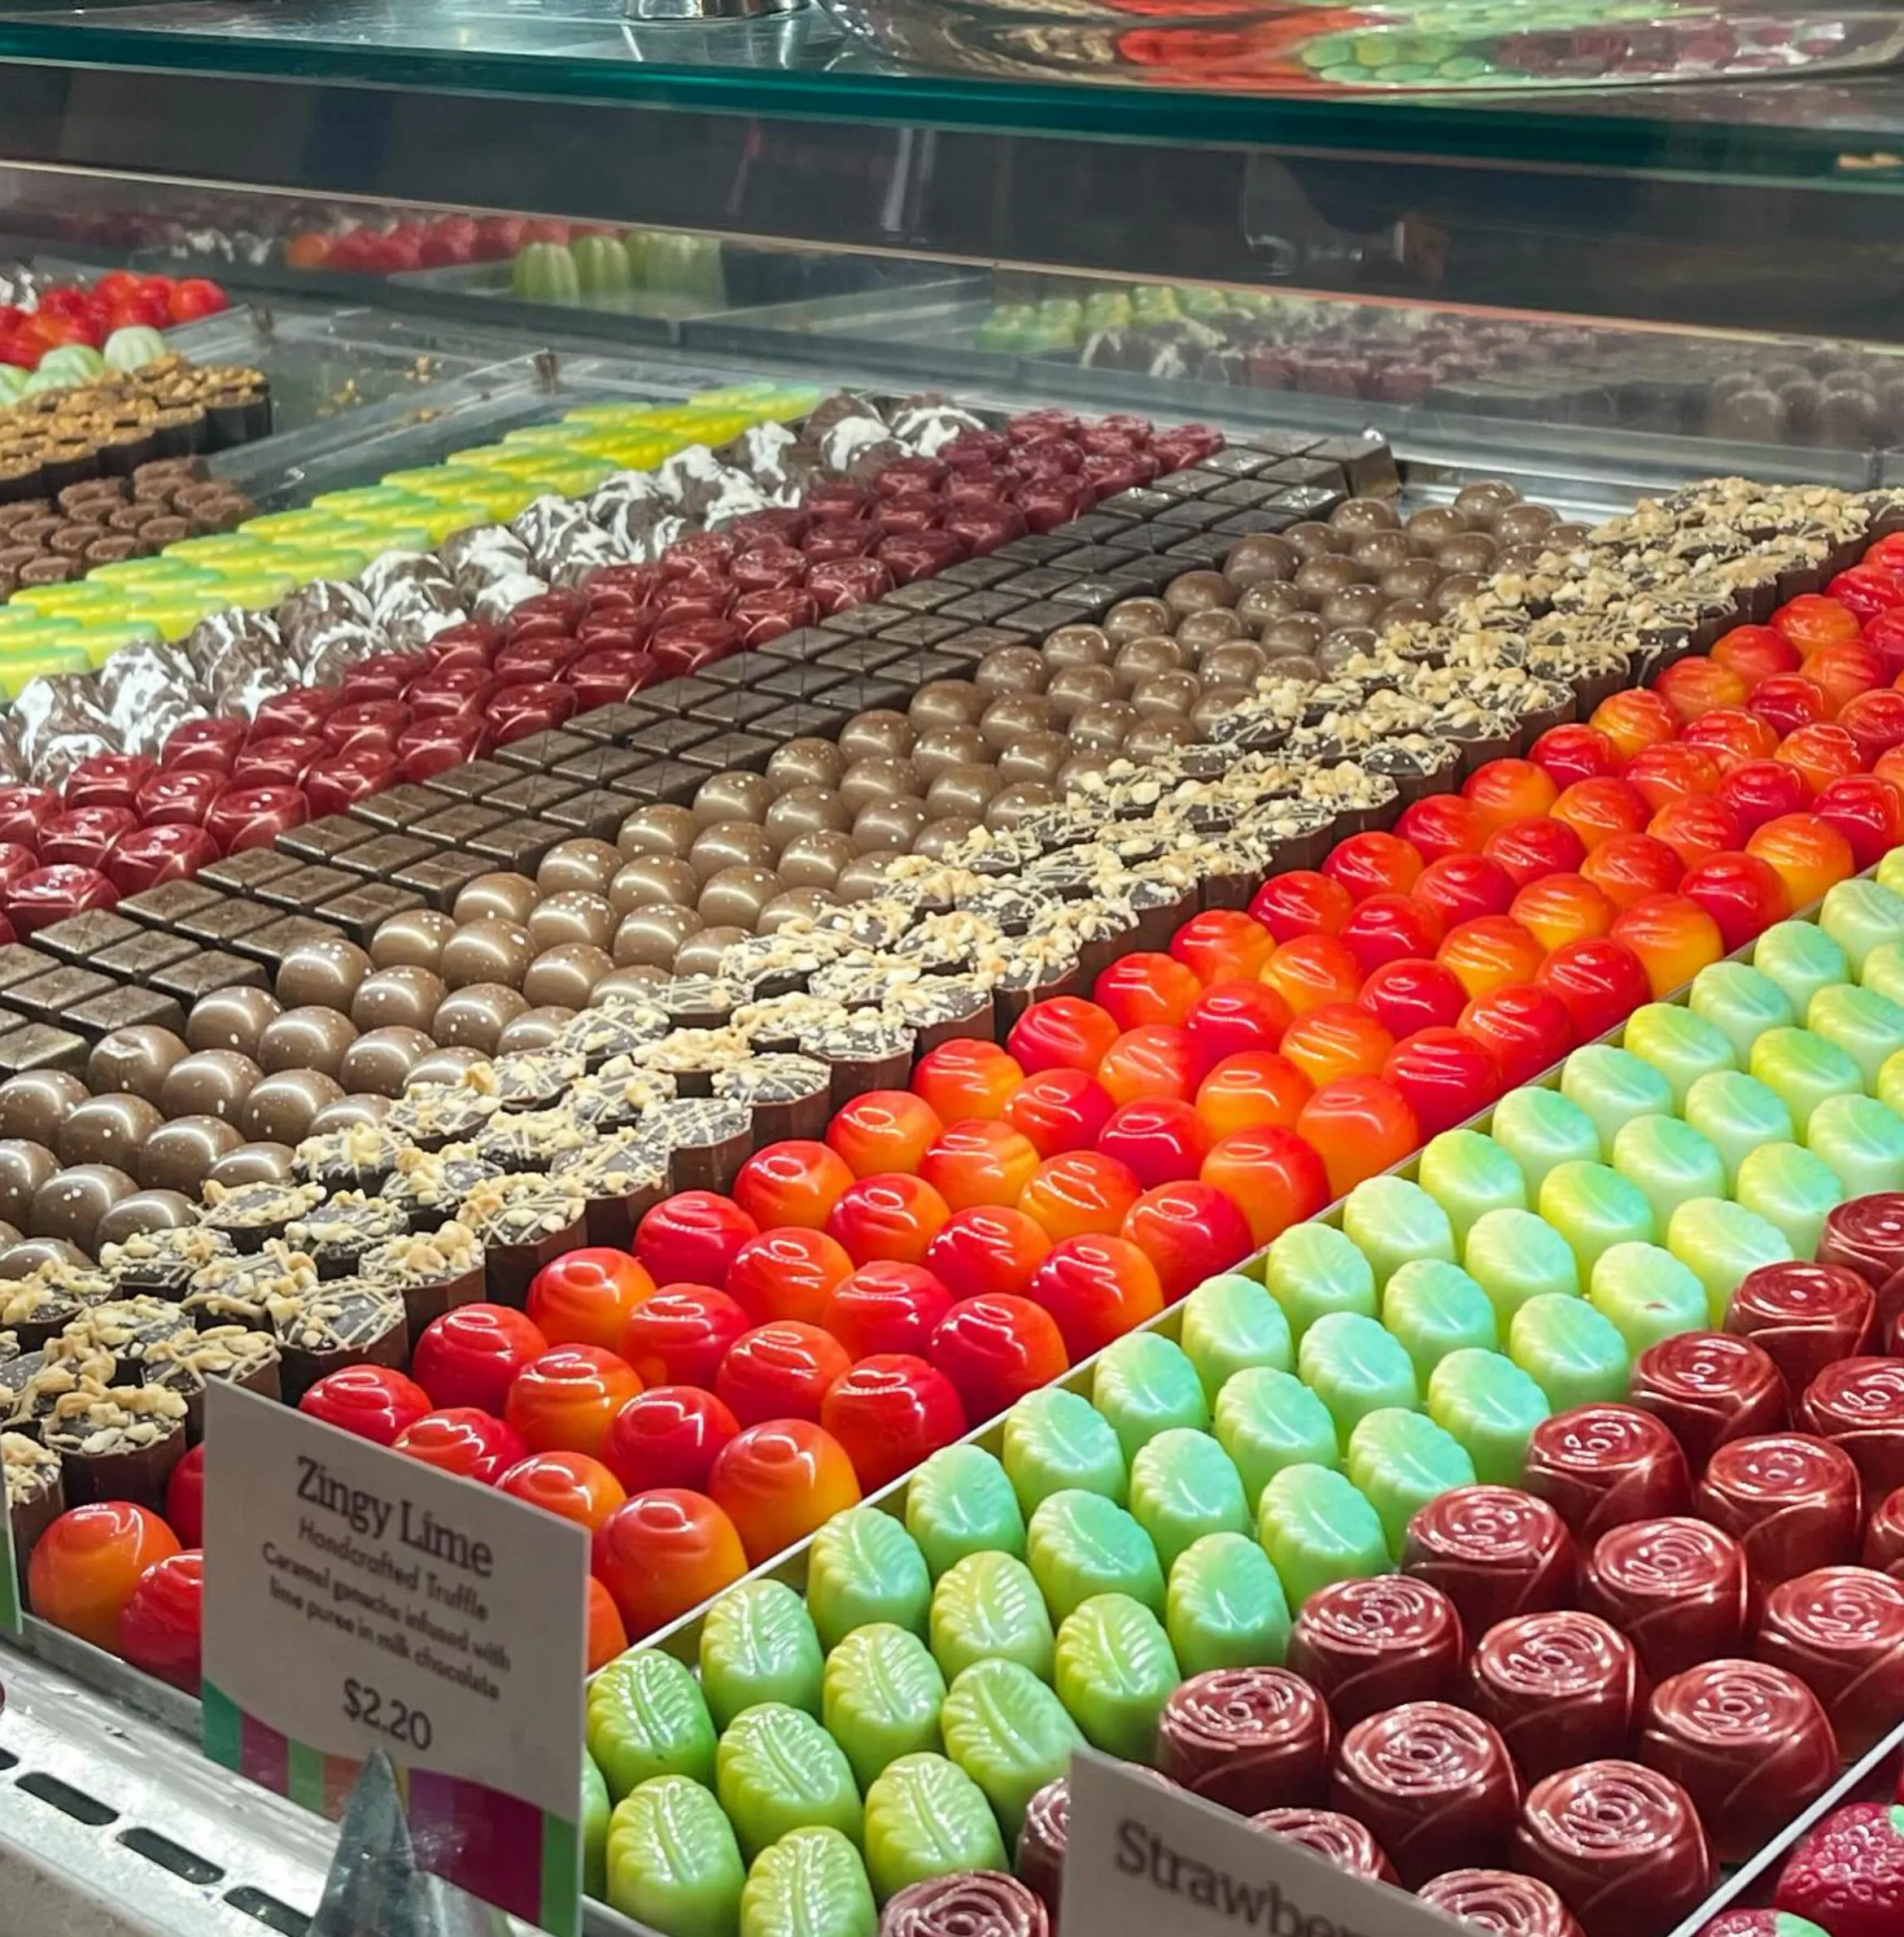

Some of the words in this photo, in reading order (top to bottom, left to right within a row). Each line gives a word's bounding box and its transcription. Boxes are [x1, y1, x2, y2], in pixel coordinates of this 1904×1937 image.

[297, 1455, 394, 1540] Zingy
[400, 1499, 493, 1577] Lime
[298, 1516, 419, 1591] Handcrafted
[426, 1571, 488, 1621] Truffle
[263, 1541, 330, 1589] Caramel
[334, 1581, 400, 1622] ganache
[405, 1604, 469, 1651] infused
[471, 1641, 511, 1673] with
[269, 1574, 304, 1610] lime
[307, 1599, 356, 1634] puree
[357, 1616, 373, 1640] in
[377, 1632, 410, 1659] milk
[414, 1646, 501, 1701] chocolate
[343, 1677, 433, 1751] $2.20
[1115, 1817, 1373, 1937] Strawbe
